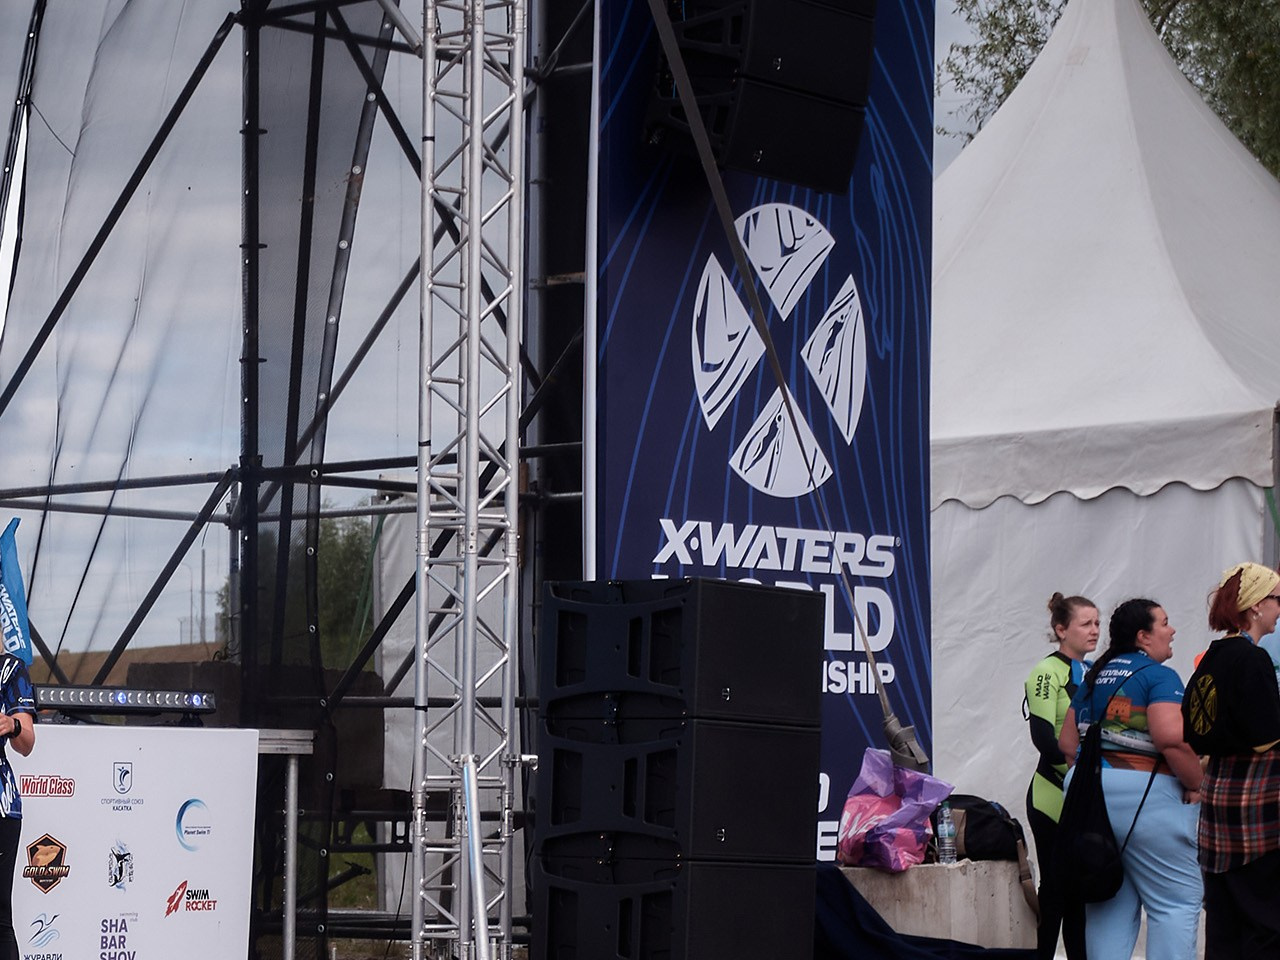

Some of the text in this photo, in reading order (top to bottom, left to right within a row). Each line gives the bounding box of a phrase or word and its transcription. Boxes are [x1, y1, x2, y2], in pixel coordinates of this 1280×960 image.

[1035, 675, 1043, 697] MAD
[1043, 673, 1051, 700] WAVE
[21, 776, 49, 796] World
[49, 777, 75, 796] Class
[24, 866, 69, 877] GOLD SWIM
[186, 890, 210, 900] SWIM
[185, 900, 217, 911] ROCKET
[101, 919, 128, 933] SHA
[100, 935, 126, 949] BAR
